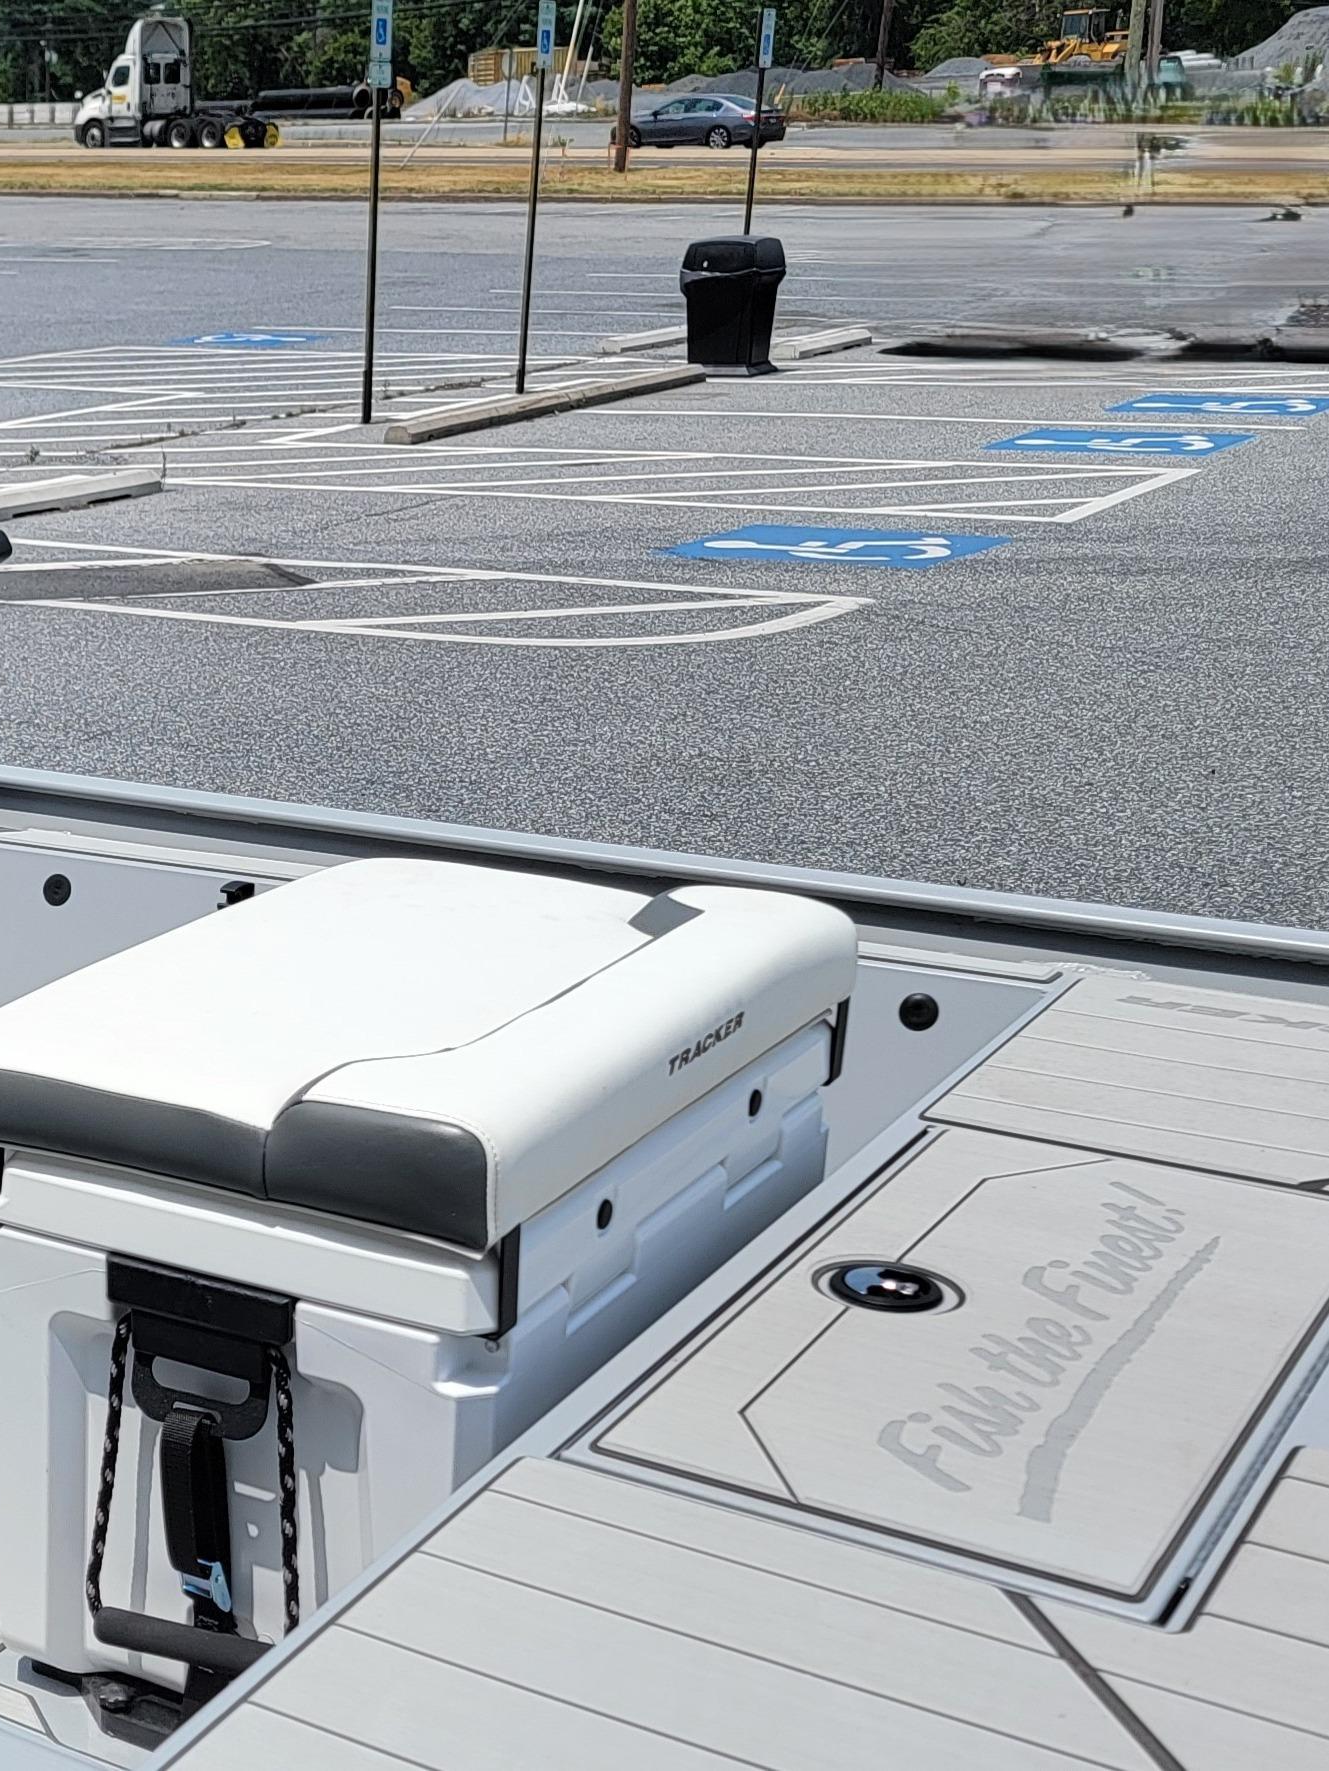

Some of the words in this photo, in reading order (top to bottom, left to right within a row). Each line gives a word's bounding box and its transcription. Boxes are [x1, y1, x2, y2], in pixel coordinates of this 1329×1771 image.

[668, 1011, 745, 1077] TRACKER
[1022, 1180, 1186, 1322] Finest!
[968, 1316, 1093, 1388] the
[876, 1382, 1042, 1493] Fish
